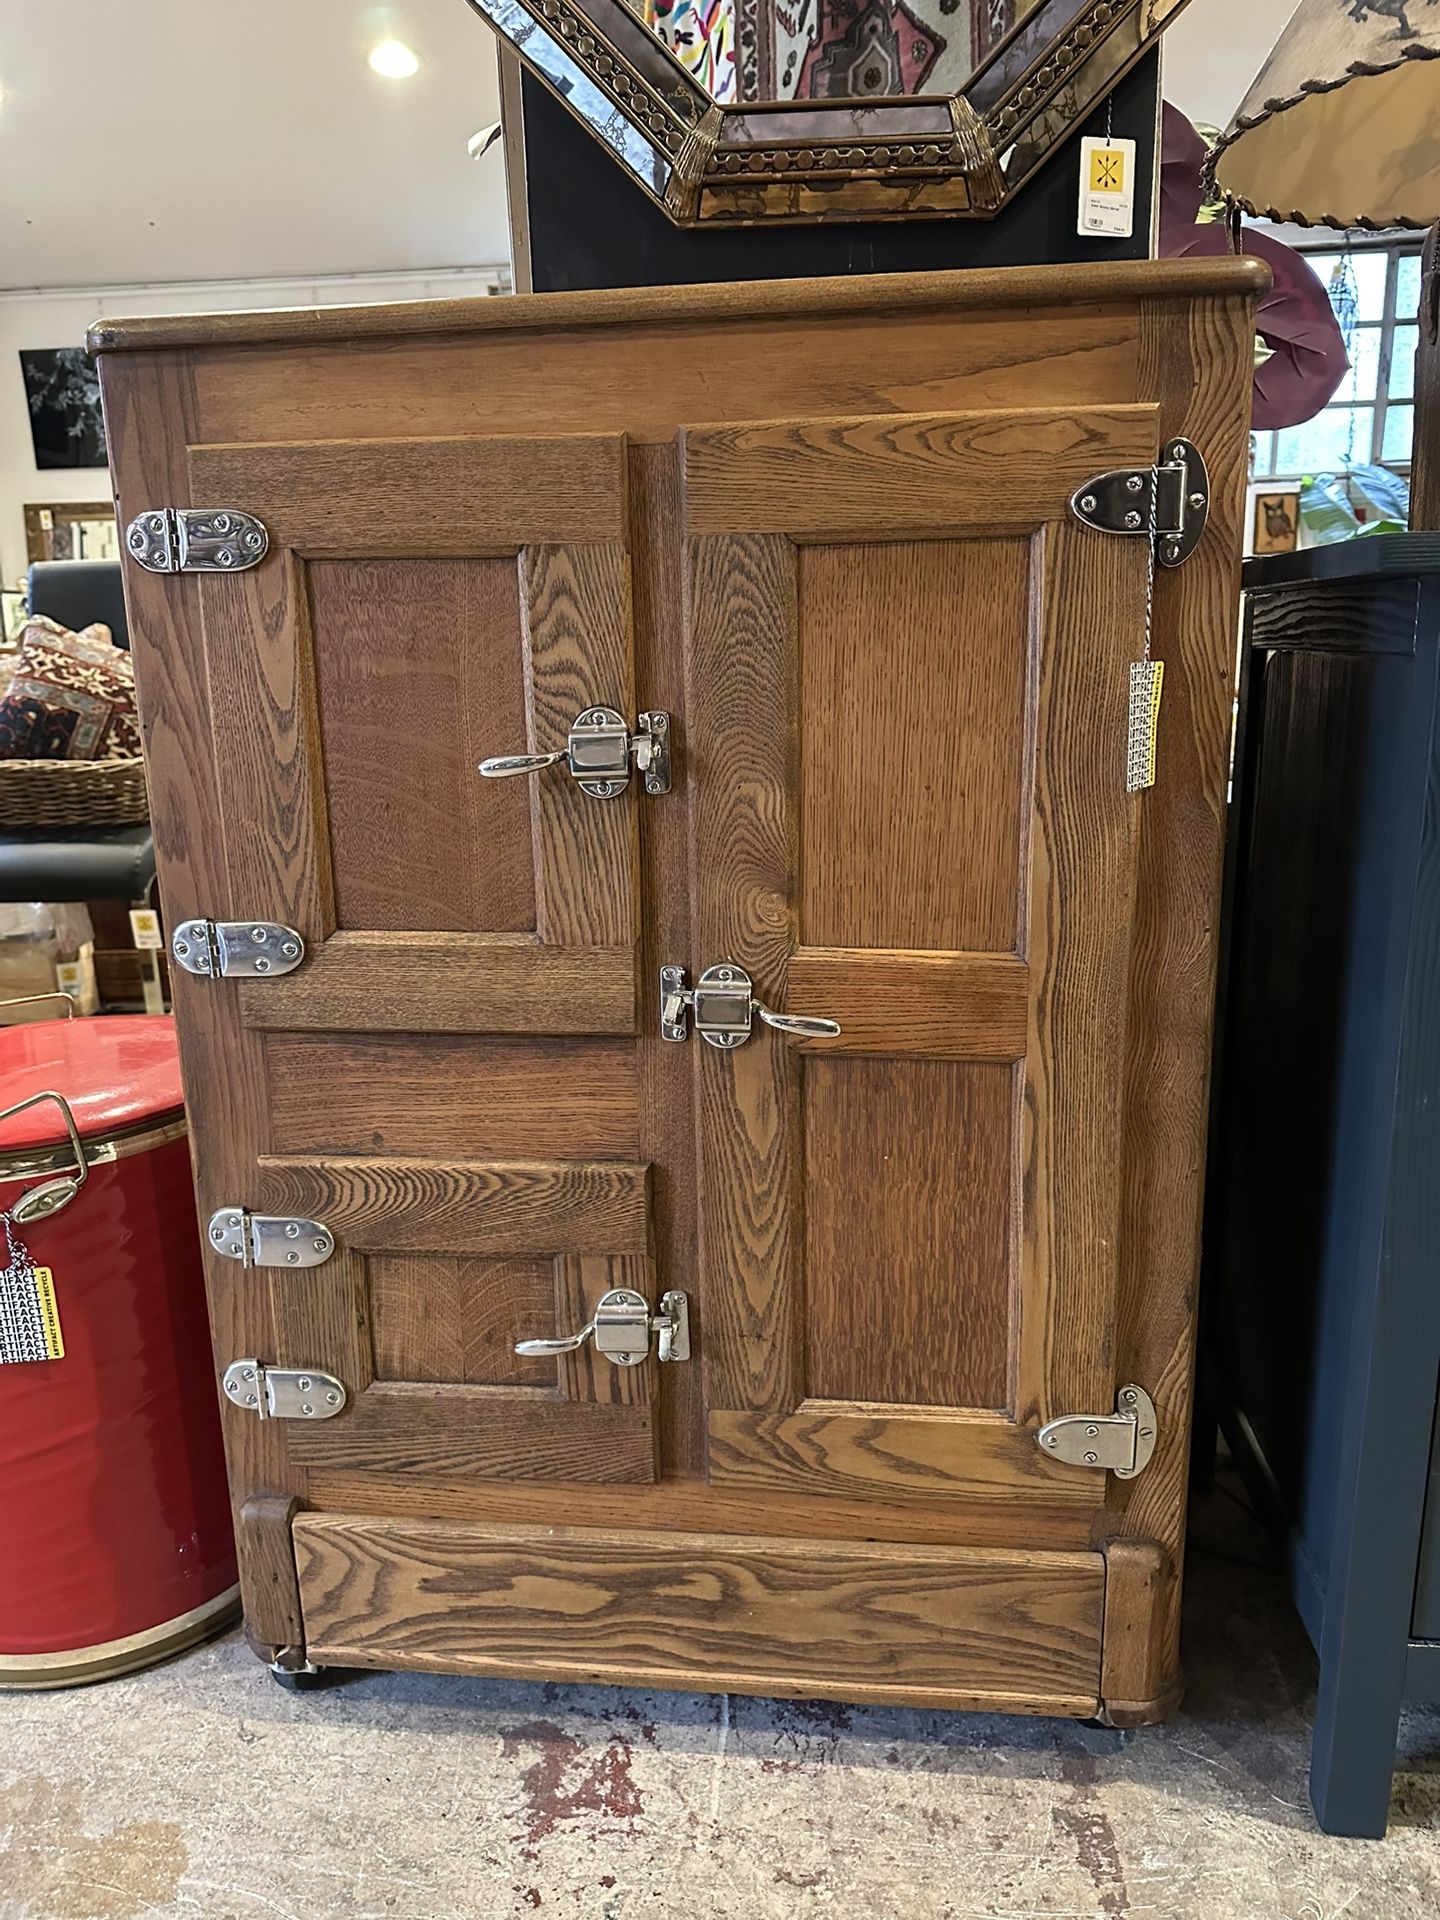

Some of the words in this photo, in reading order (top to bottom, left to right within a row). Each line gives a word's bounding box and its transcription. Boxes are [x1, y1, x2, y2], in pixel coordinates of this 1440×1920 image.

[1131, 670, 1156, 681] ARTIFACT
[1131, 681, 1155, 693] ARTIFACT
[1131, 692, 1153, 704] ARTIFACT
[1130, 703, 1152, 716] ARTIFACT
[1130, 714, 1152, 727] ARTIFACT
[1130, 725, 1151, 738] ARTIFACT
[1129, 736, 1151, 750] ARTIFACT
[1129, 747, 1150, 761] ARTIFACT
[1128, 758, 1150, 773] ARTIFACT
[1128, 769, 1149, 784] ARTIFACT
[41, 1270, 50, 1297] RECYCLE
[0, 1307, 42, 1317] TIFACT
